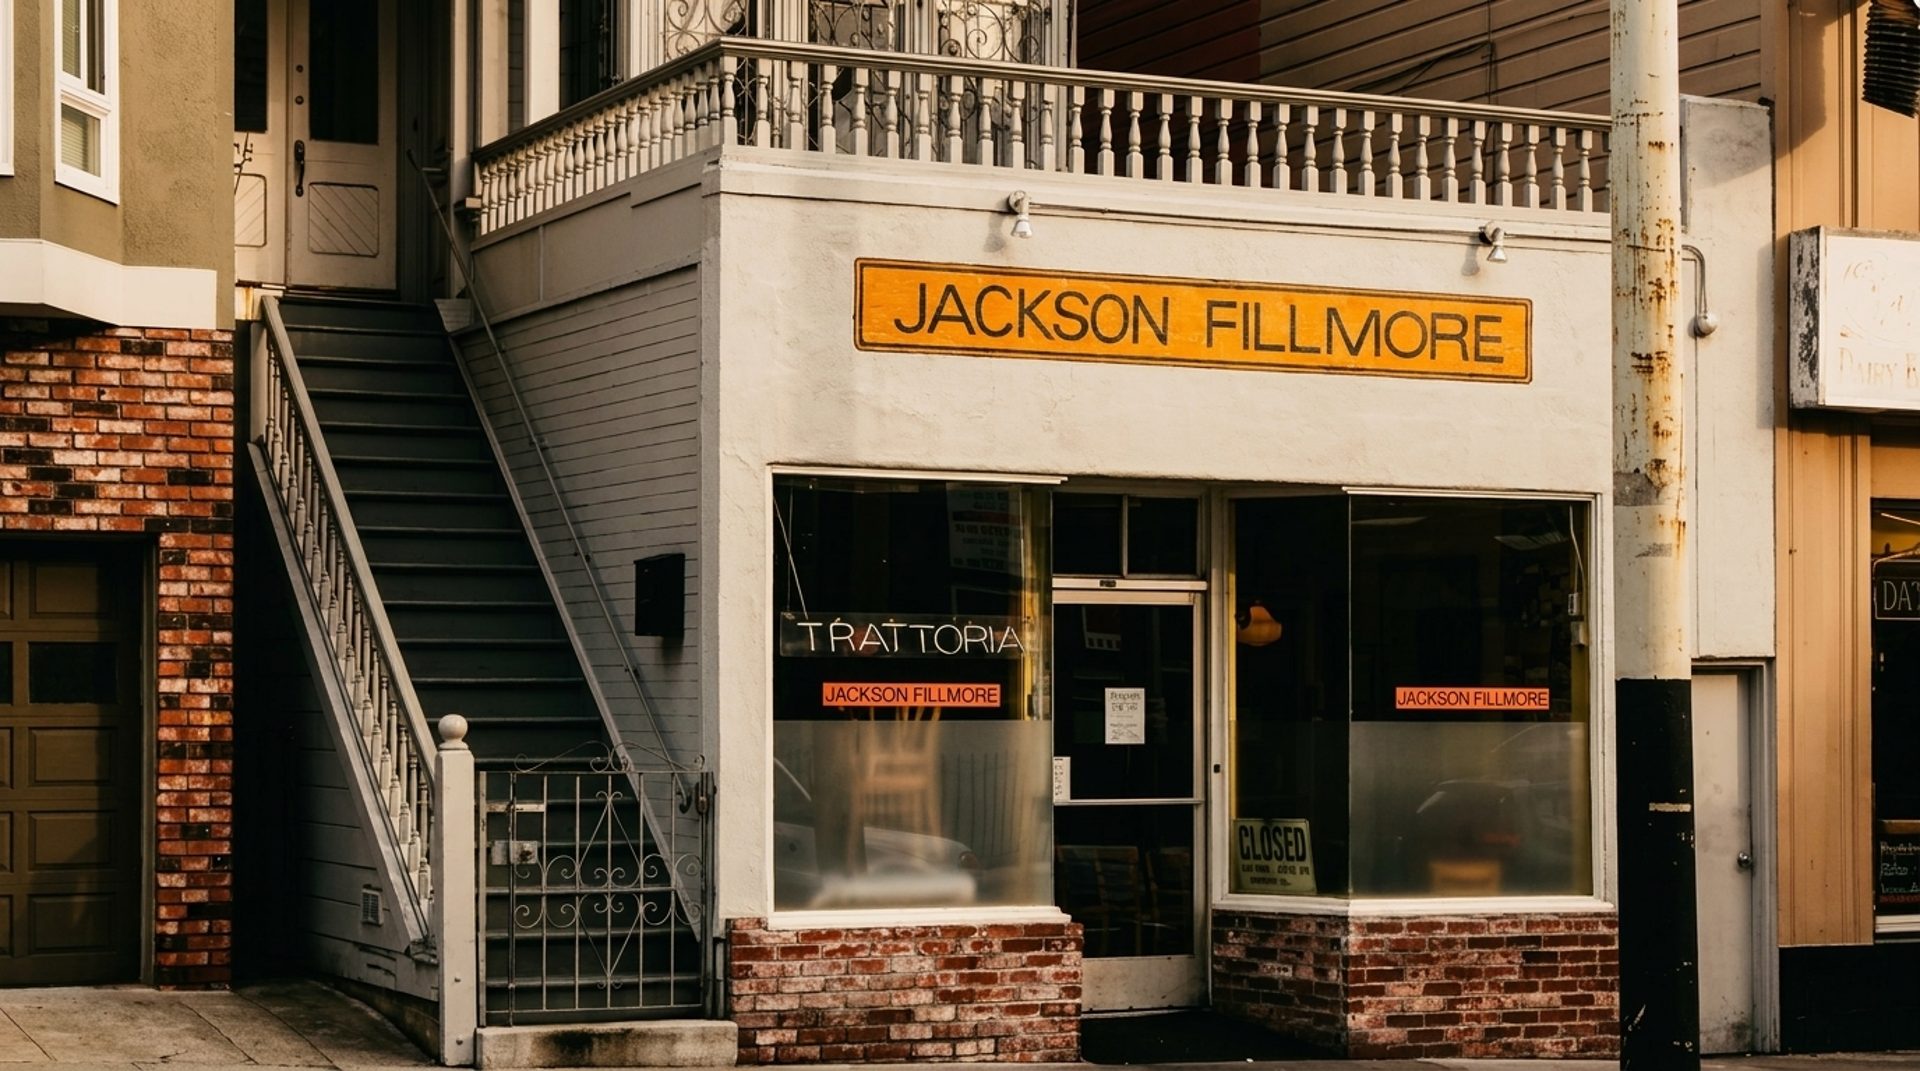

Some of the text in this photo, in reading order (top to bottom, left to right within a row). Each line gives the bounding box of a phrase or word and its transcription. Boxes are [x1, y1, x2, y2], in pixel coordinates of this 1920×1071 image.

[893, 282, 1505, 364] JACKSON FILLMORE
[796, 620, 1026, 655] TRATTORIA
[825, 686, 998, 704] JACKSON FILLMORE
[1397, 690, 1548, 707] JACKSON FILLMORE
[1238, 825, 1307, 862] CLOSED
